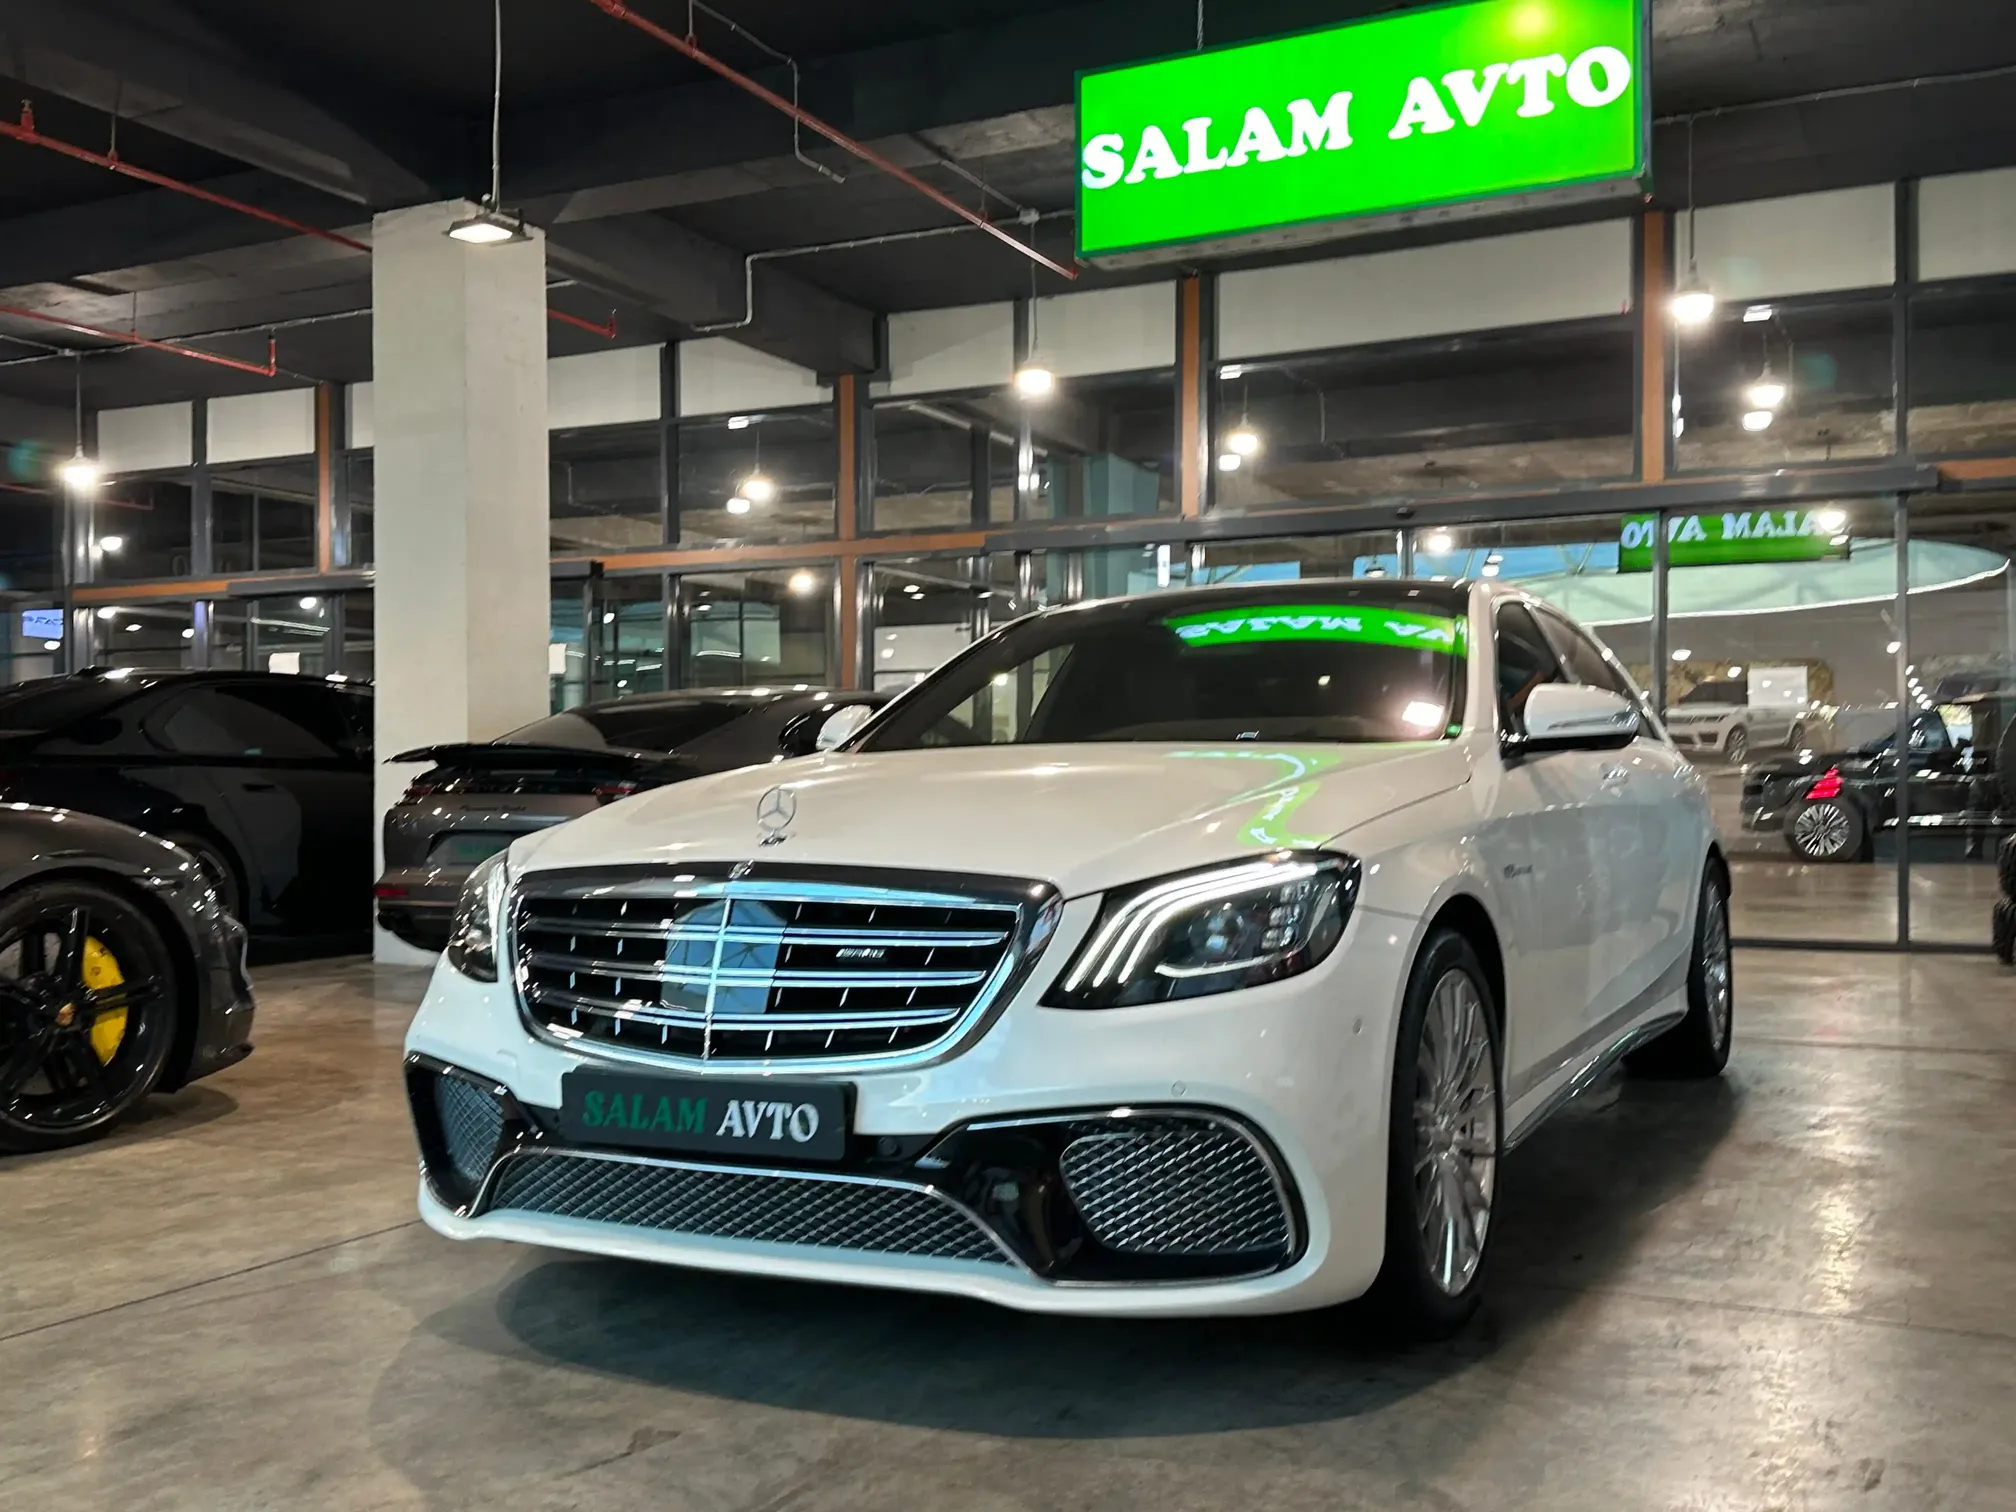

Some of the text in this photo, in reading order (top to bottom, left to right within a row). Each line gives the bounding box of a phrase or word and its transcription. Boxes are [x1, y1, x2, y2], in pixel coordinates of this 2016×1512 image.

[1081, 45, 1631, 189] SALAM AVTO
[582, 1090, 820, 1143] SALAM AVTO
